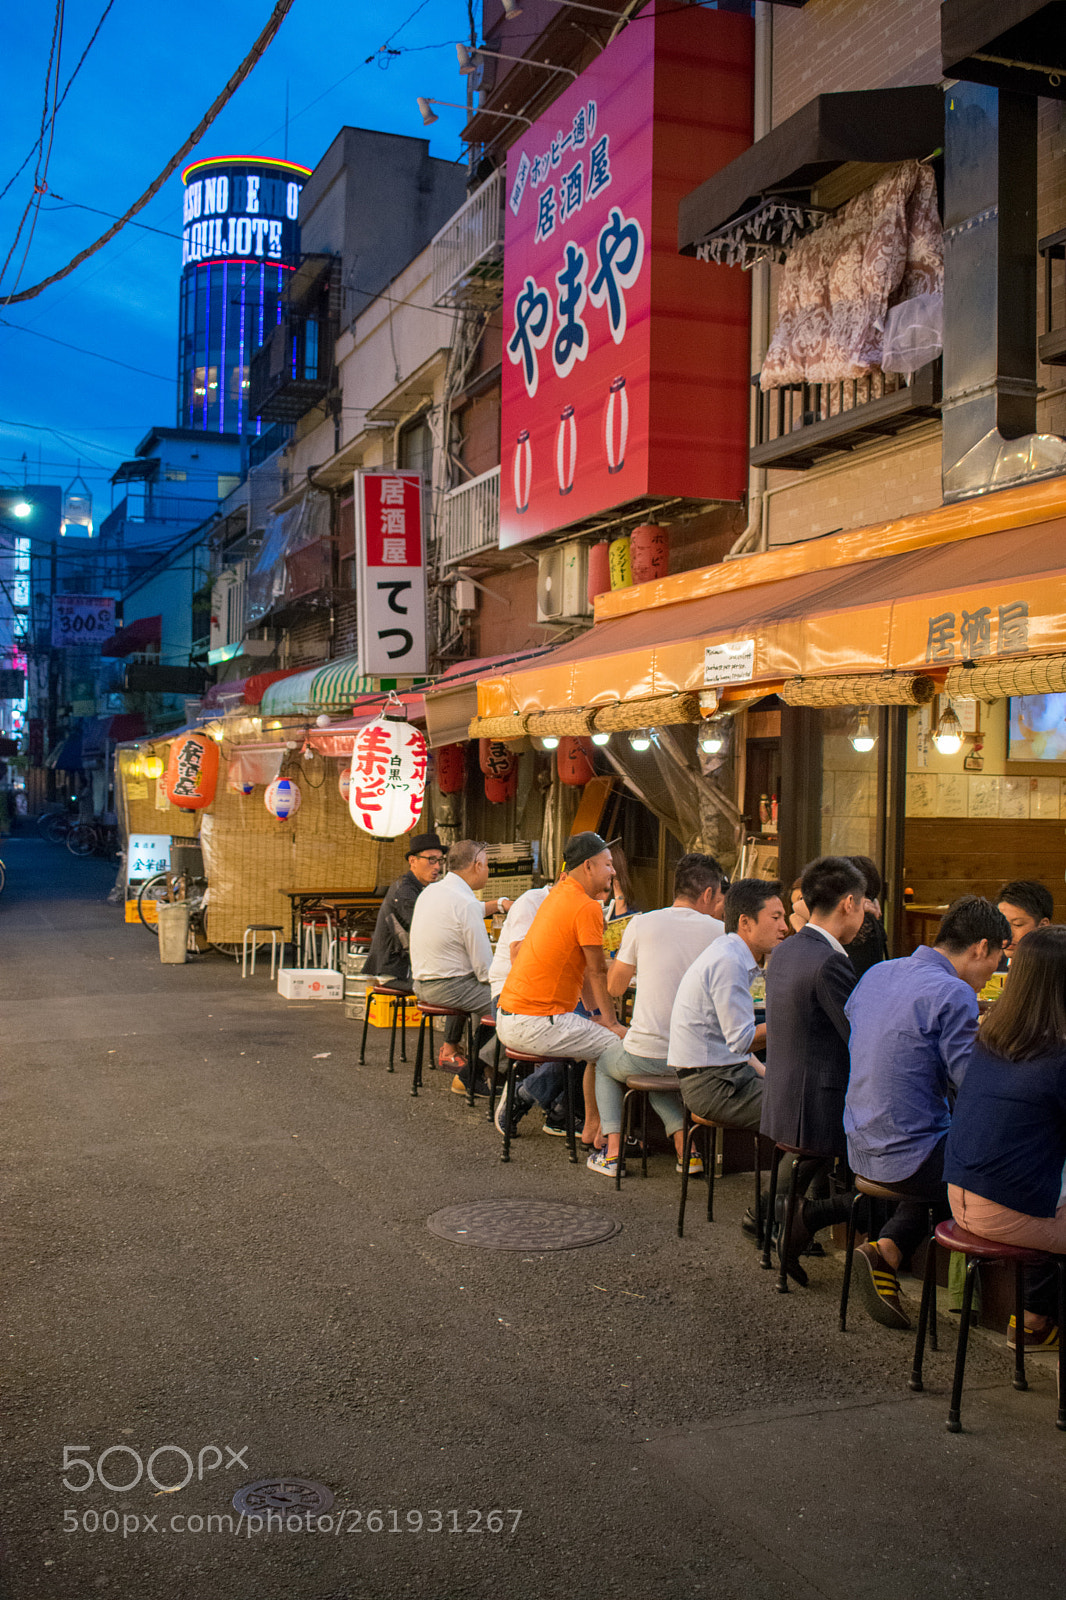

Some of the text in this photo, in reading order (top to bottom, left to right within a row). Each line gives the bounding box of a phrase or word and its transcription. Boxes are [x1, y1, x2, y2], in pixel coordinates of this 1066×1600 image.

[531, 100, 596, 188] ホッピー通り
[204, 176, 229, 215] NO
[534, 134, 612, 244] 居酒屋
[507, 206, 644, 398] やまや
[379, 478, 408, 564] 居酒屋
[377, 581, 414, 659] てつ
[926, 600, 1030, 663] 居酒屋
[355, 726, 393, 830] 生ホッピー
[385, 783, 410, 791] ハーフ
